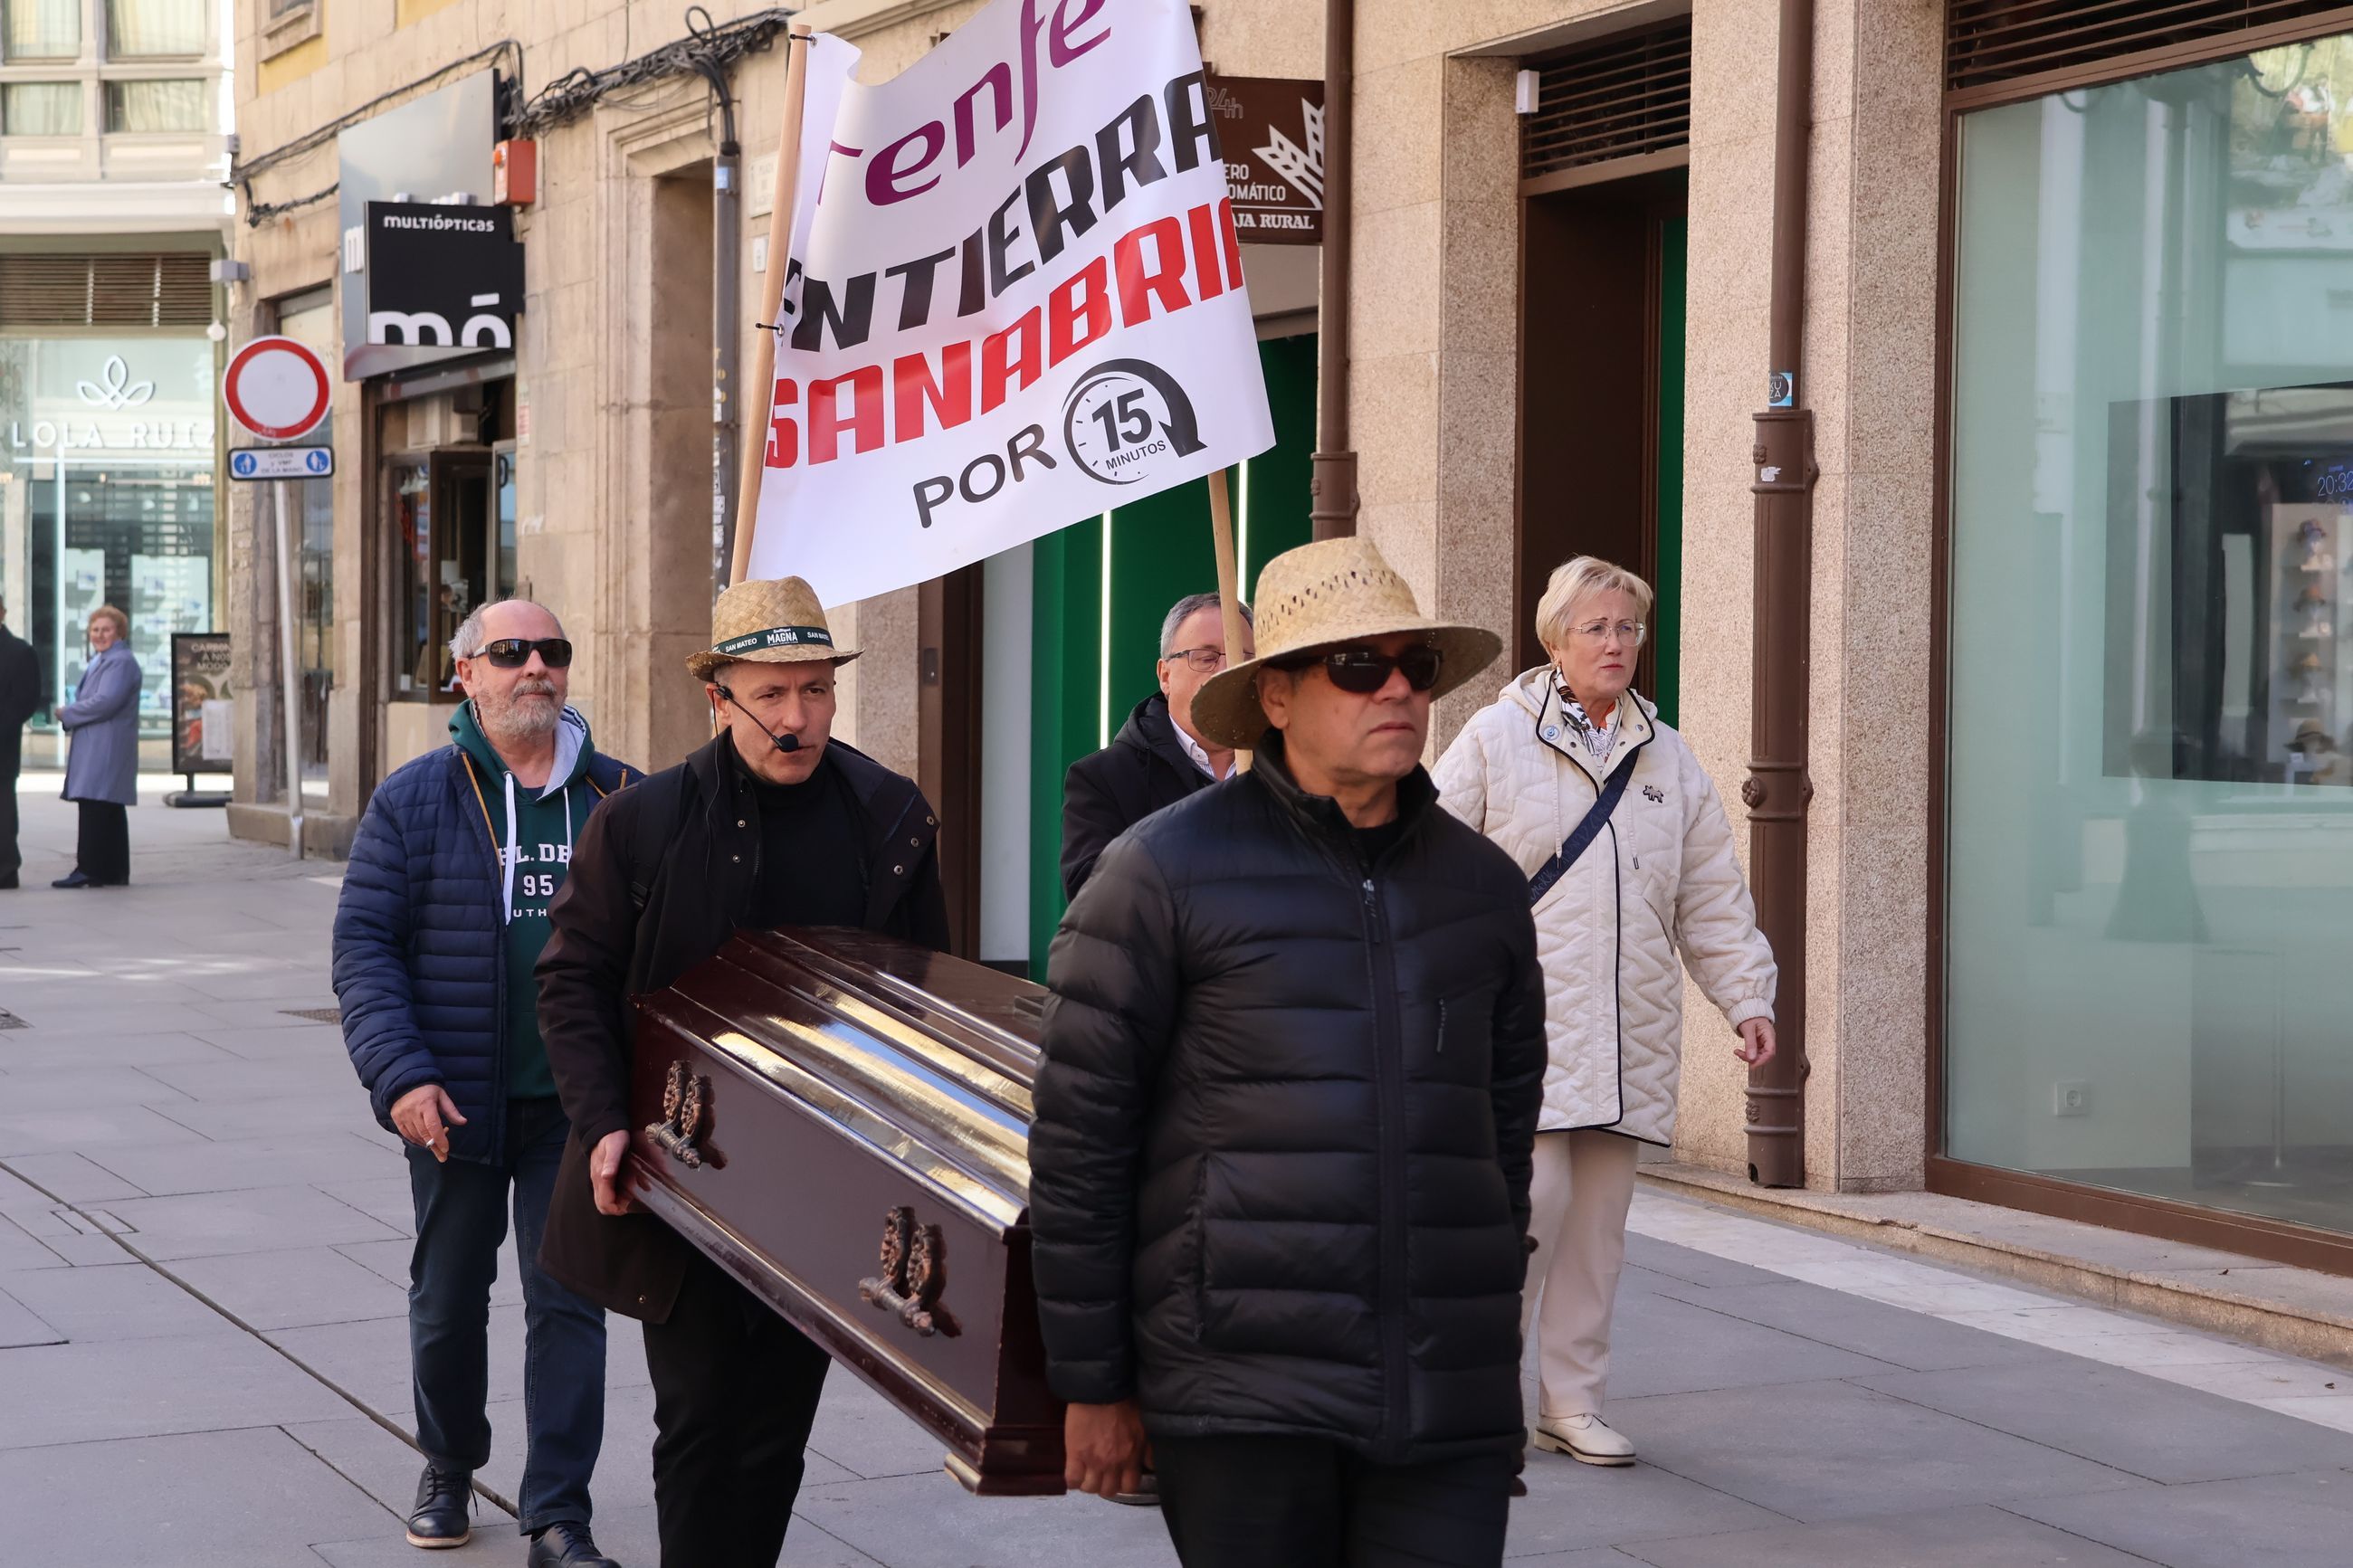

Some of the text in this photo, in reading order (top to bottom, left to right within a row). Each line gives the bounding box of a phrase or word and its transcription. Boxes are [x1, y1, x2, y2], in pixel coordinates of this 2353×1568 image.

[1260, 214, 1314, 229] RURAL
[1091, 388, 1152, 452] 15
[12, 421, 105, 448] LOLA
[1106, 441, 1167, 470] MINUTOS
[913, 423, 1057, 528] POR
[2317, 470, 2353, 498] 20:32
[726, 644, 736, 652] SAN
[736, 637, 757, 649] MATEO
[767, 632, 798, 644] MAGNA
[523, 874, 554, 897] 95
[513, 908, 547, 917] UTH
